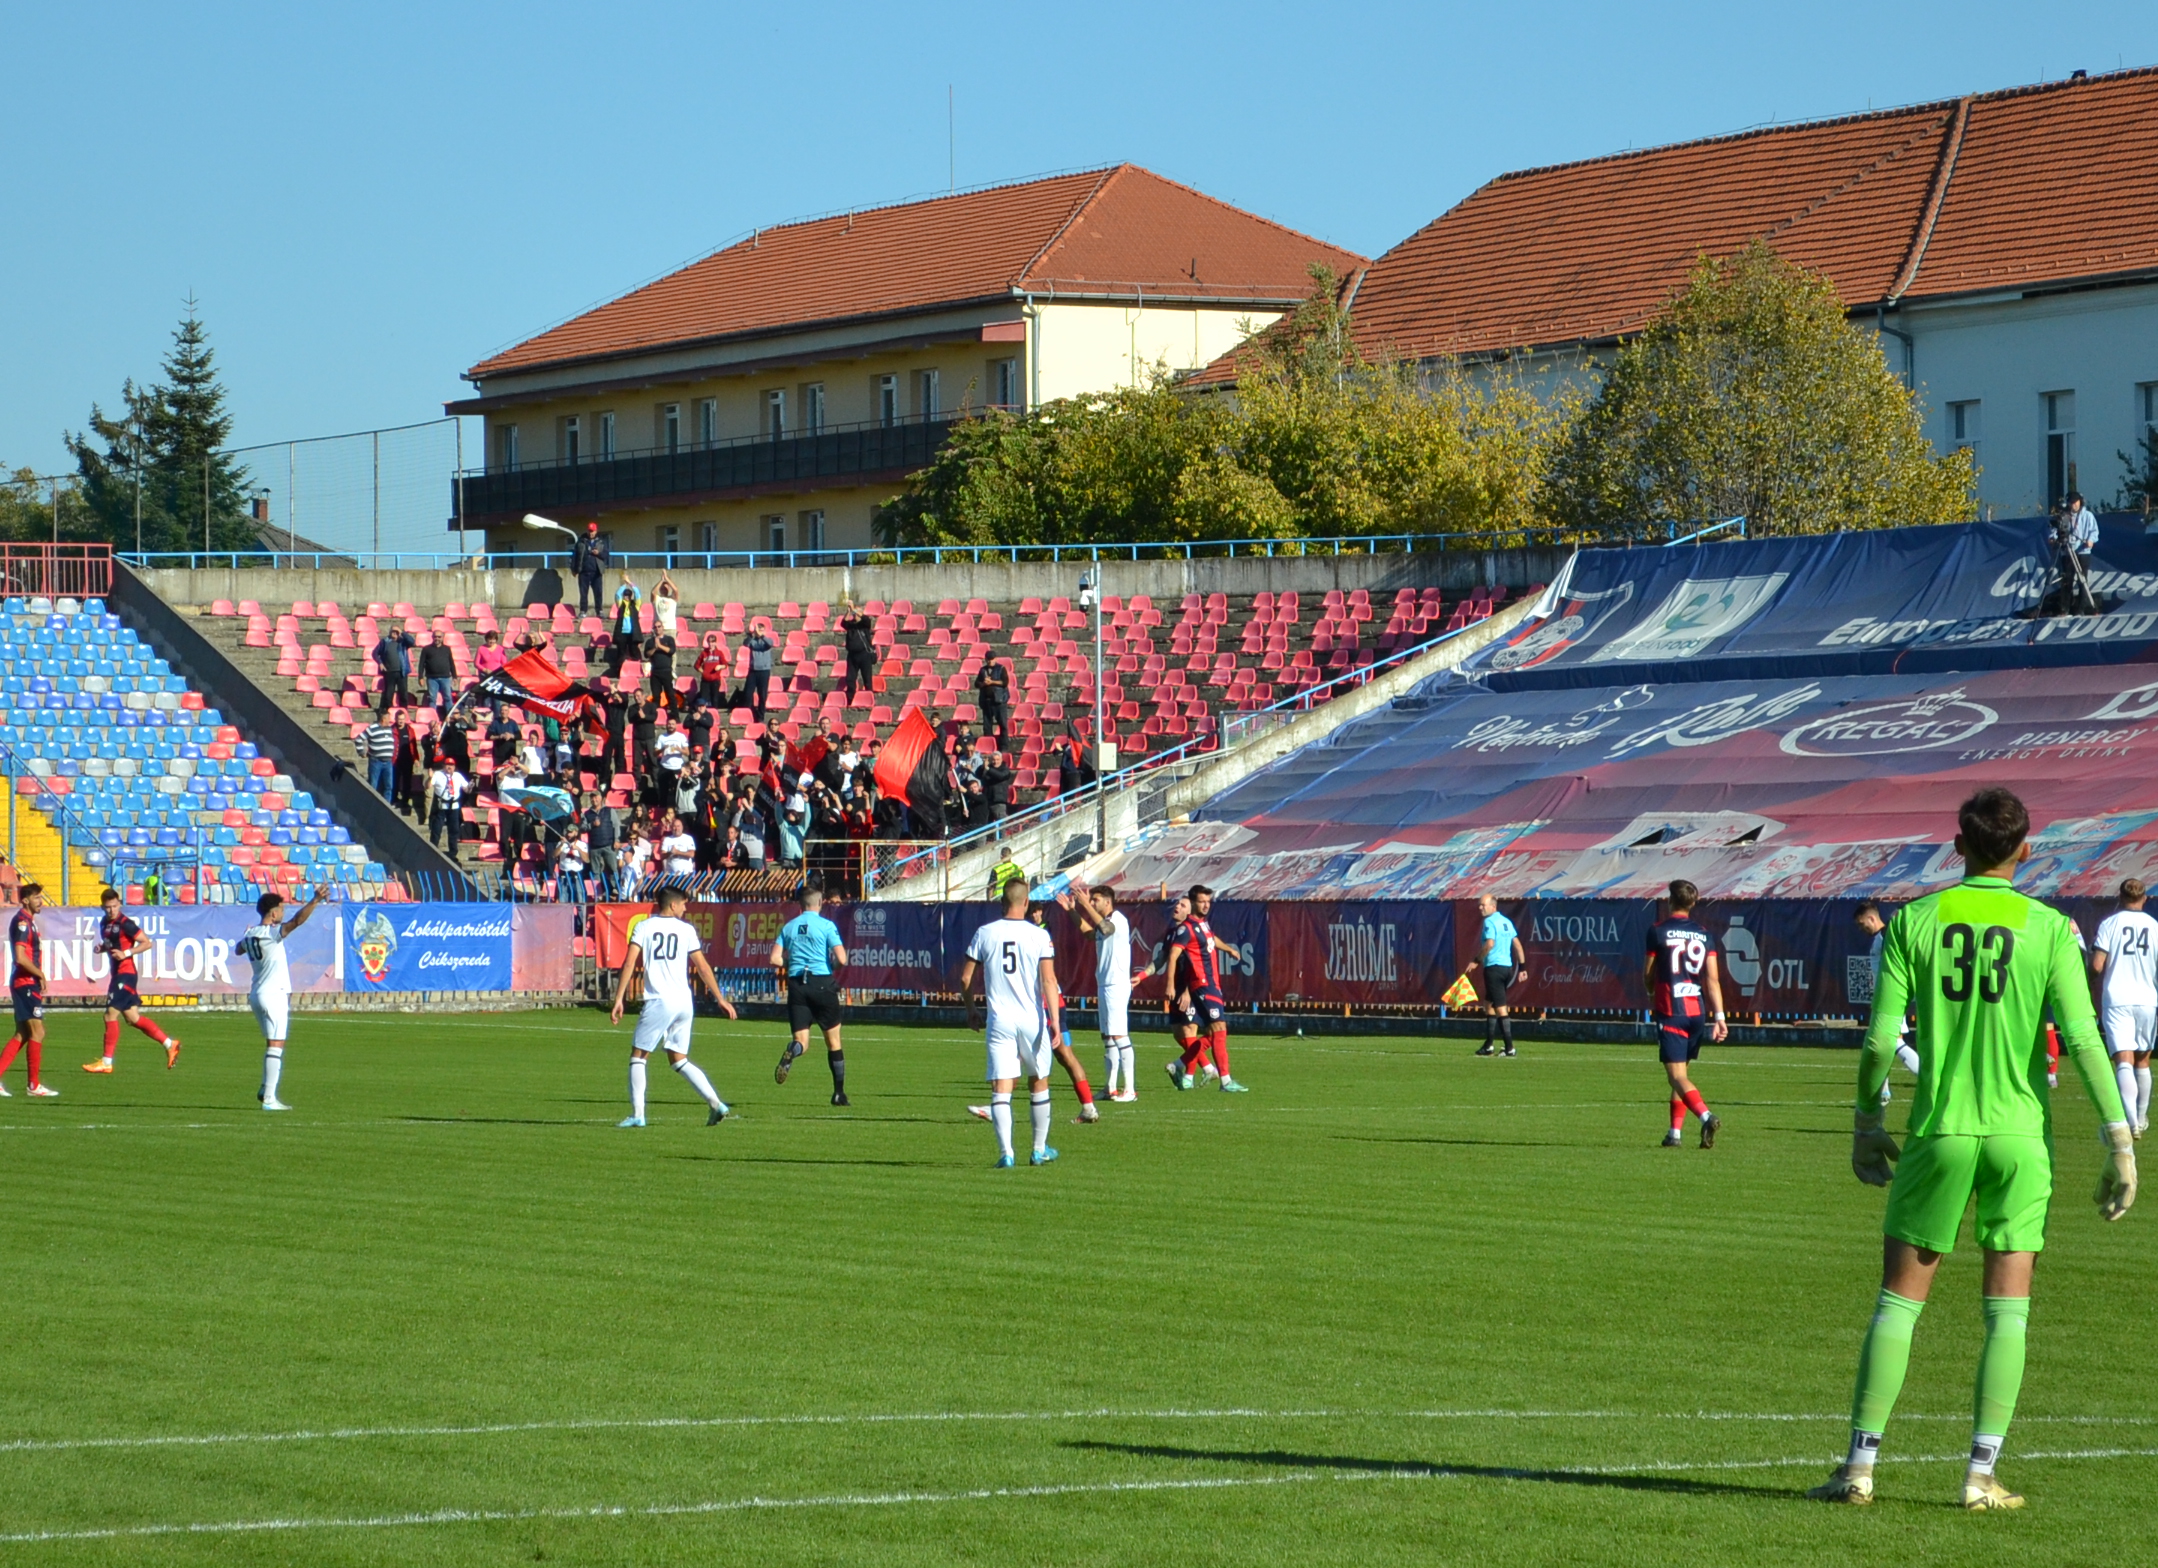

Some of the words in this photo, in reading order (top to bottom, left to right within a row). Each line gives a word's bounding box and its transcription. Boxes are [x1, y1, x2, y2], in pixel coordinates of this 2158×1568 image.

[1810, 721, 1953, 740] REGAL
[2009, 729, 2149, 745] RIENERGY
[1959, 748, 2048, 760] ENERGY
[2059, 746, 2134, 758] DRINK
[401, 919, 510, 941] Lokálpatrióták
[1529, 916, 1620, 942] ASTORIA
[2122, 926, 2149, 956] 24
[653, 932, 678, 960] 20
[1003, 941, 1017, 974] 5
[1325, 914, 1397, 981] JÉRÔME
[1666, 939, 1706, 974] 79
[419, 951, 491, 971] Csíkszereda
[1768, 959, 1809, 989] OTL
[1941, 923, 2014, 1004] 33
